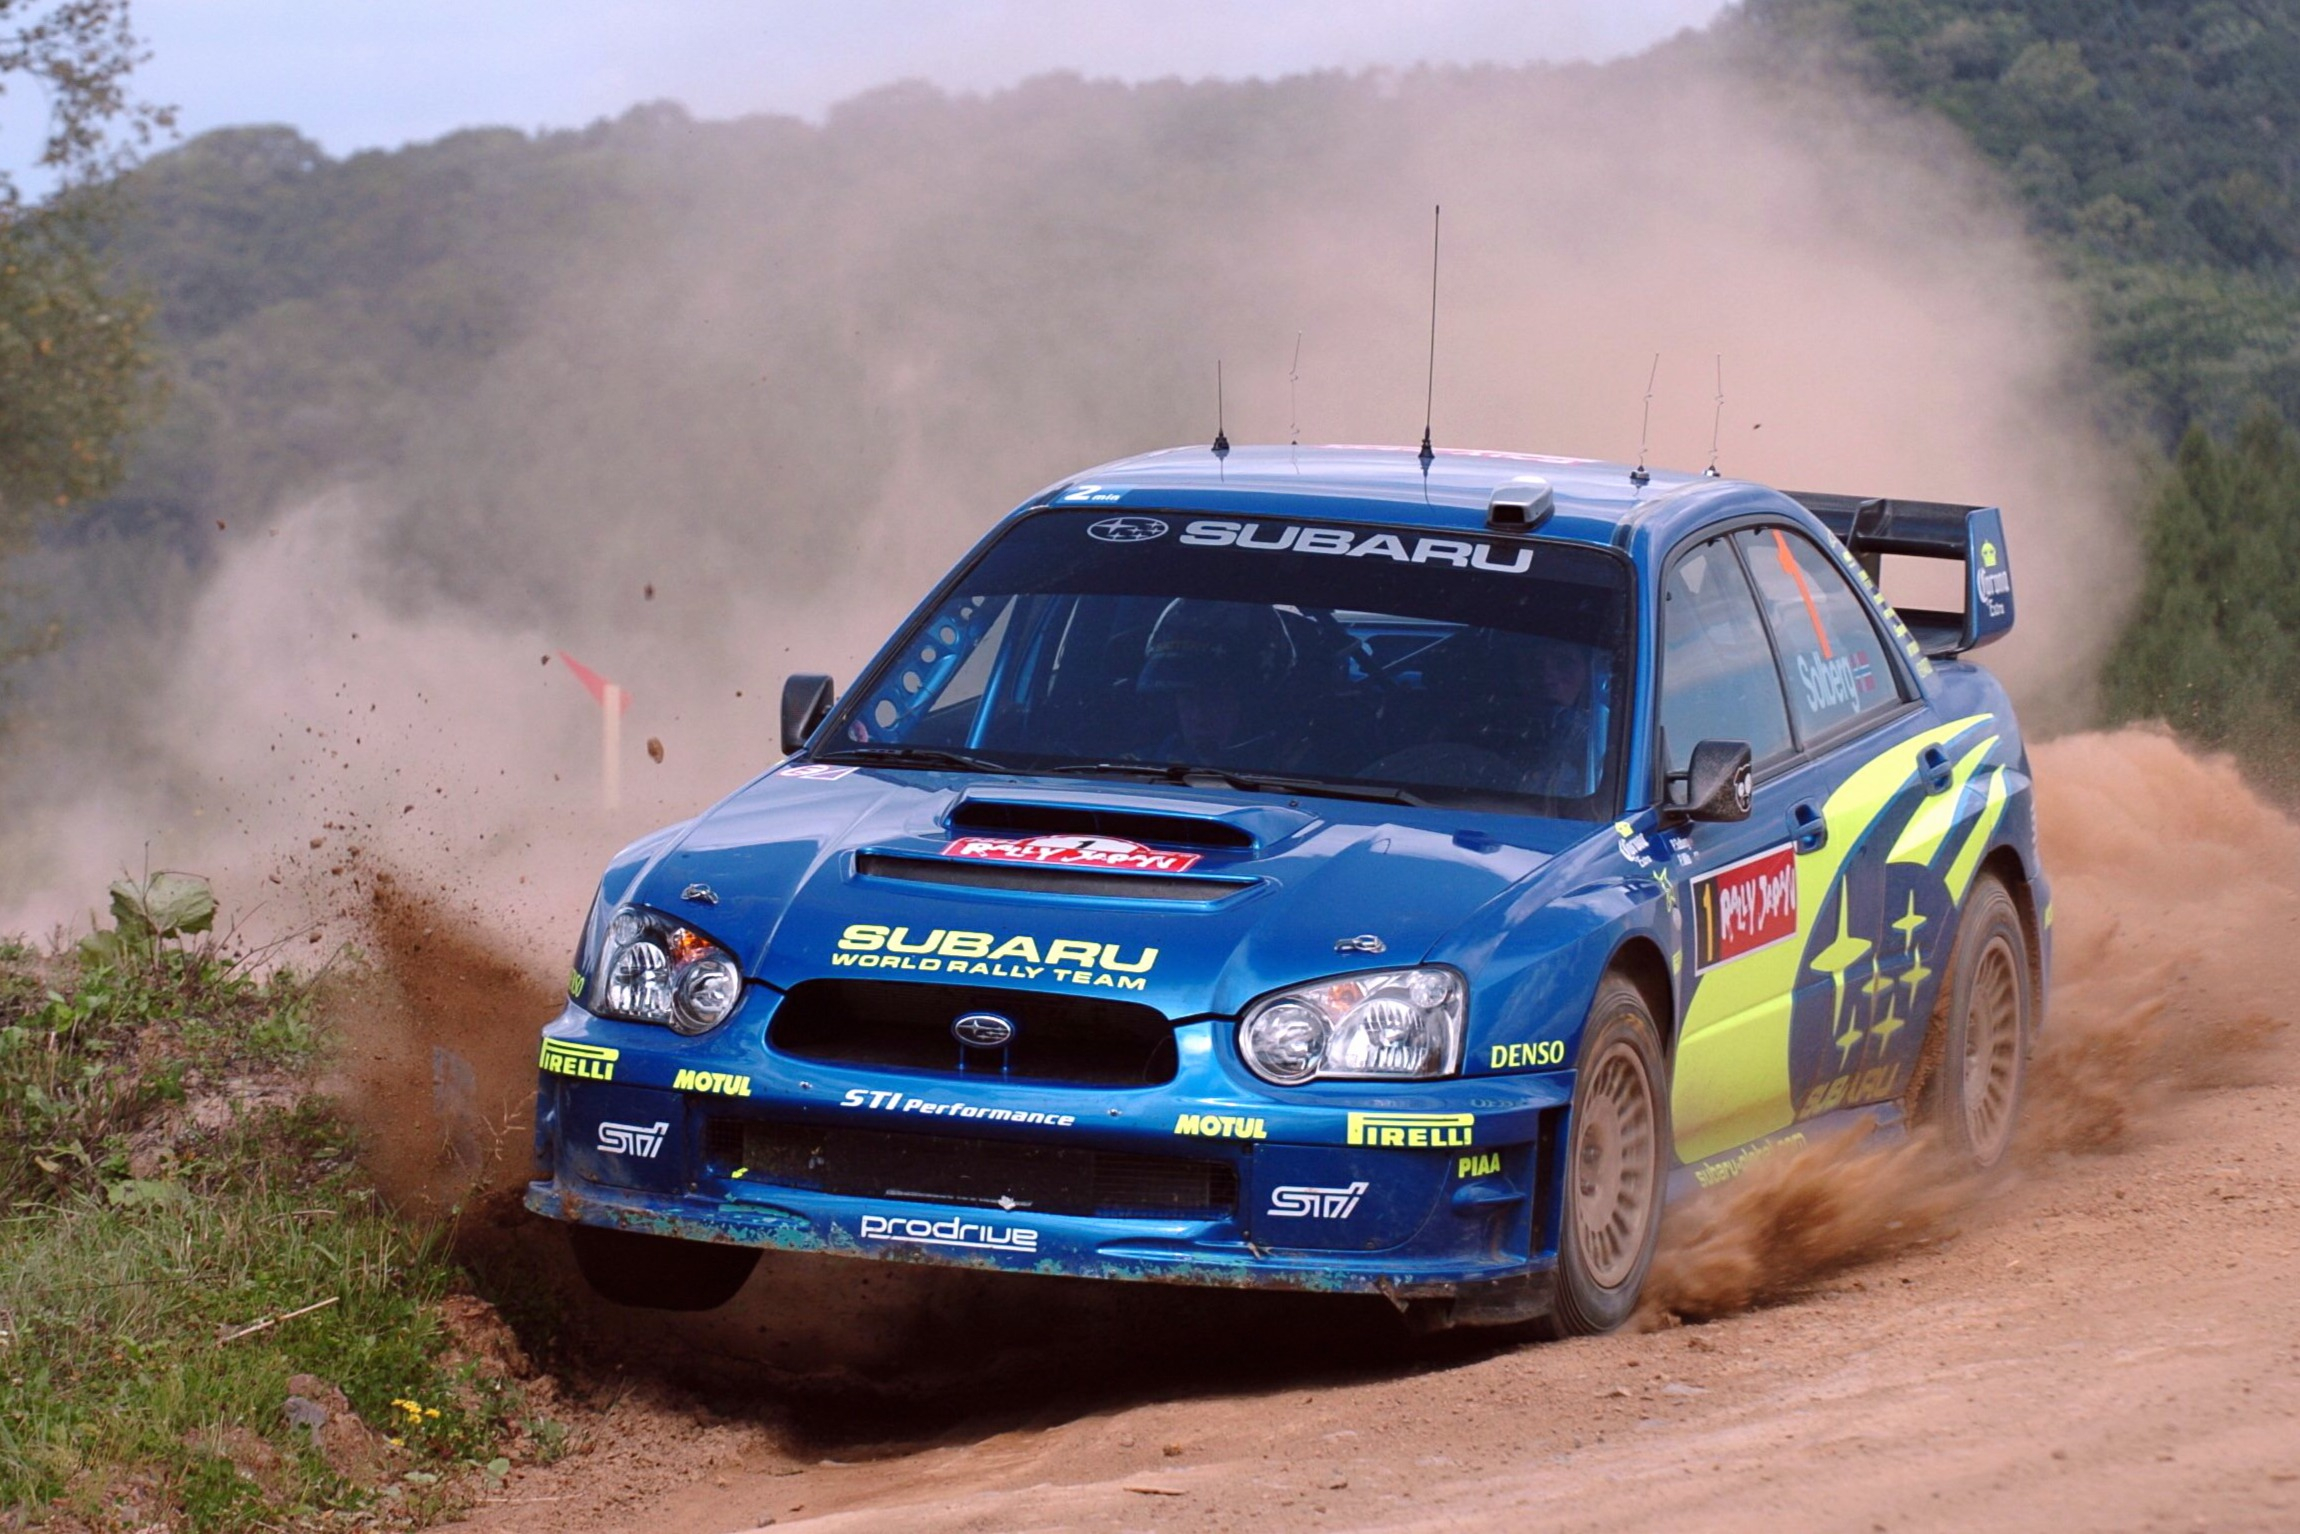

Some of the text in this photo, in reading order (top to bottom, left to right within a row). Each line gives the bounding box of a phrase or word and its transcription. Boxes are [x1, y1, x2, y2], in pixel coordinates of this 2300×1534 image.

[1064, 485, 1120, 501] 2 min
[1179, 520, 1534, 574] SUBARU
[1797, 650, 1861, 714] Solberg
[1075, 840, 1096, 849] 1
[1702, 882, 1714, 963] 1
[837, 923, 1159, 973] SUBARU
[831, 952, 1147, 991] WORLD RALLY TEAM
[538, 1036, 620, 1082] PIRELLI
[1490, 1039, 1565, 1069] DENSO
[672, 1068, 752, 1098] MOTUL
[840, 1088, 1077, 1127] STI Performance
[1173, 1113, 1268, 1140] MOTUL
[1346, 1111, 1476, 1147] PIRELLI
[1458, 1152, 1501, 1179] PIAA
